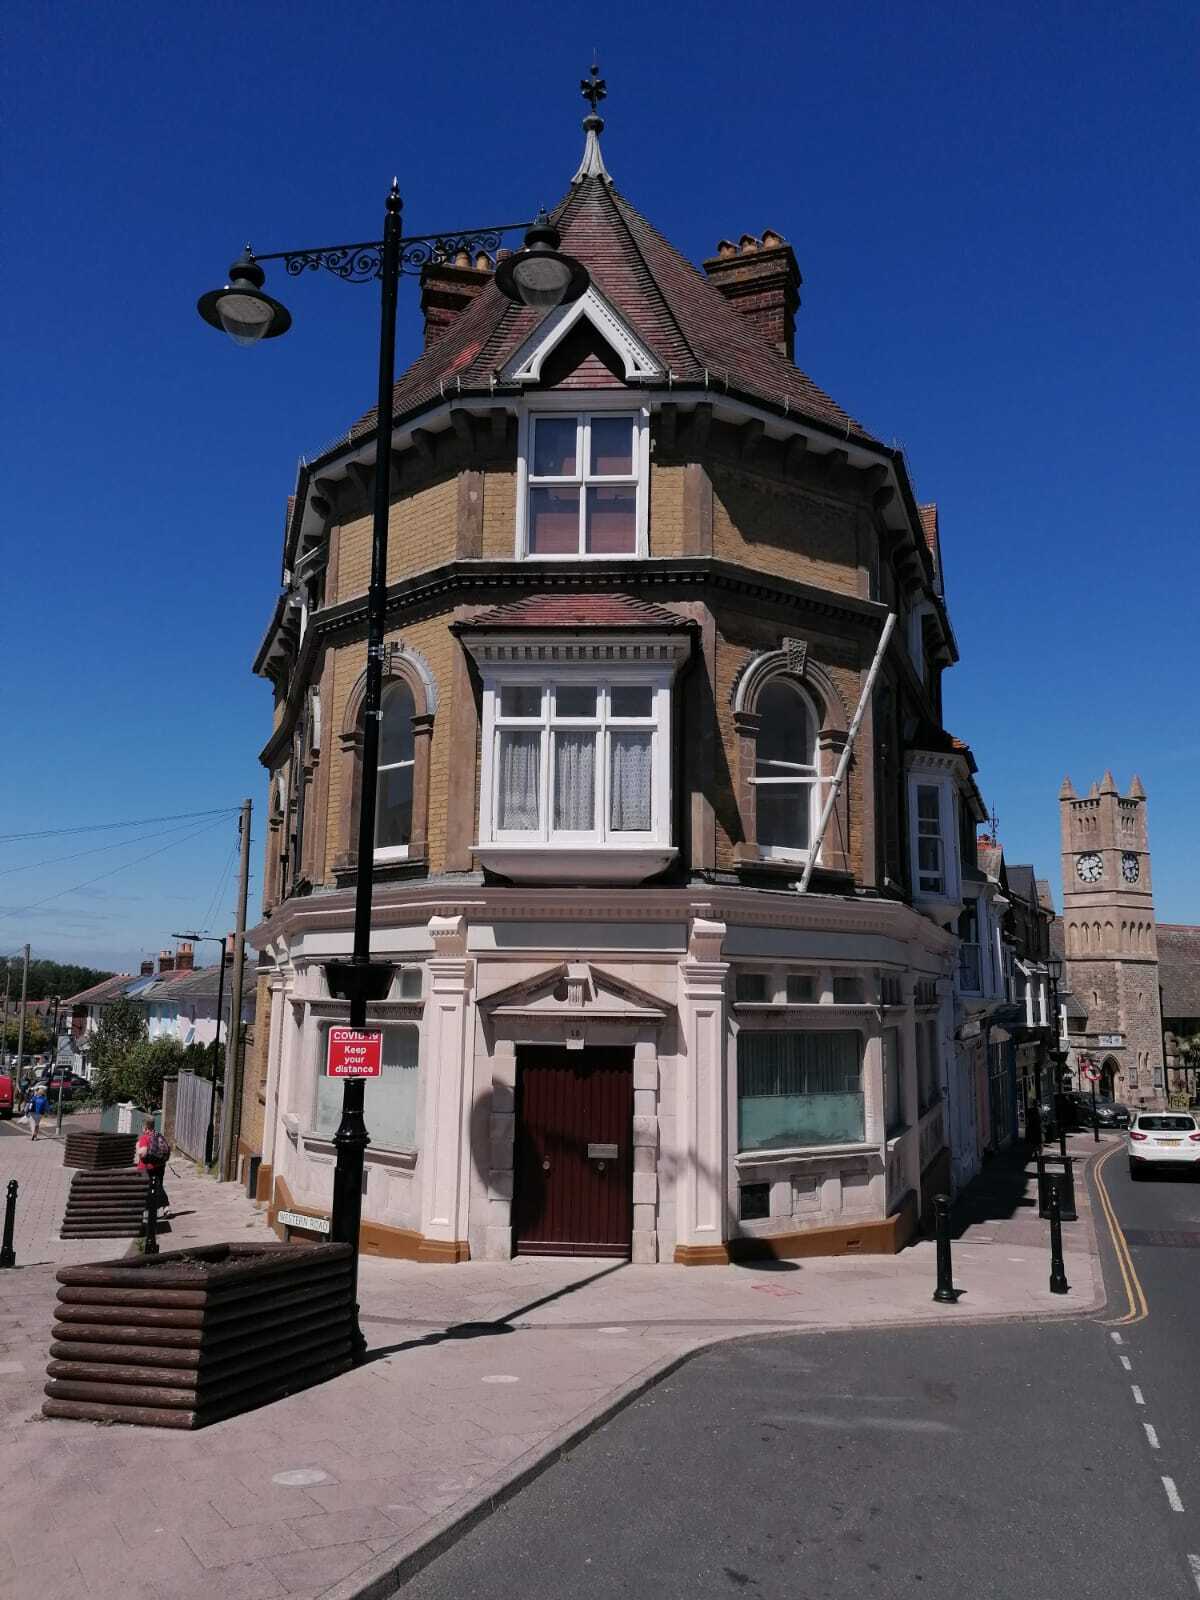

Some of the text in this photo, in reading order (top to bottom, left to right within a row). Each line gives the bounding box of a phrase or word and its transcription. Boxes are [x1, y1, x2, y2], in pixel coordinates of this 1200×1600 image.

[344, 1046, 367, 1055] Keep
[344, 1056, 365, 1064] your
[335, 1064, 374, 1073] distance
